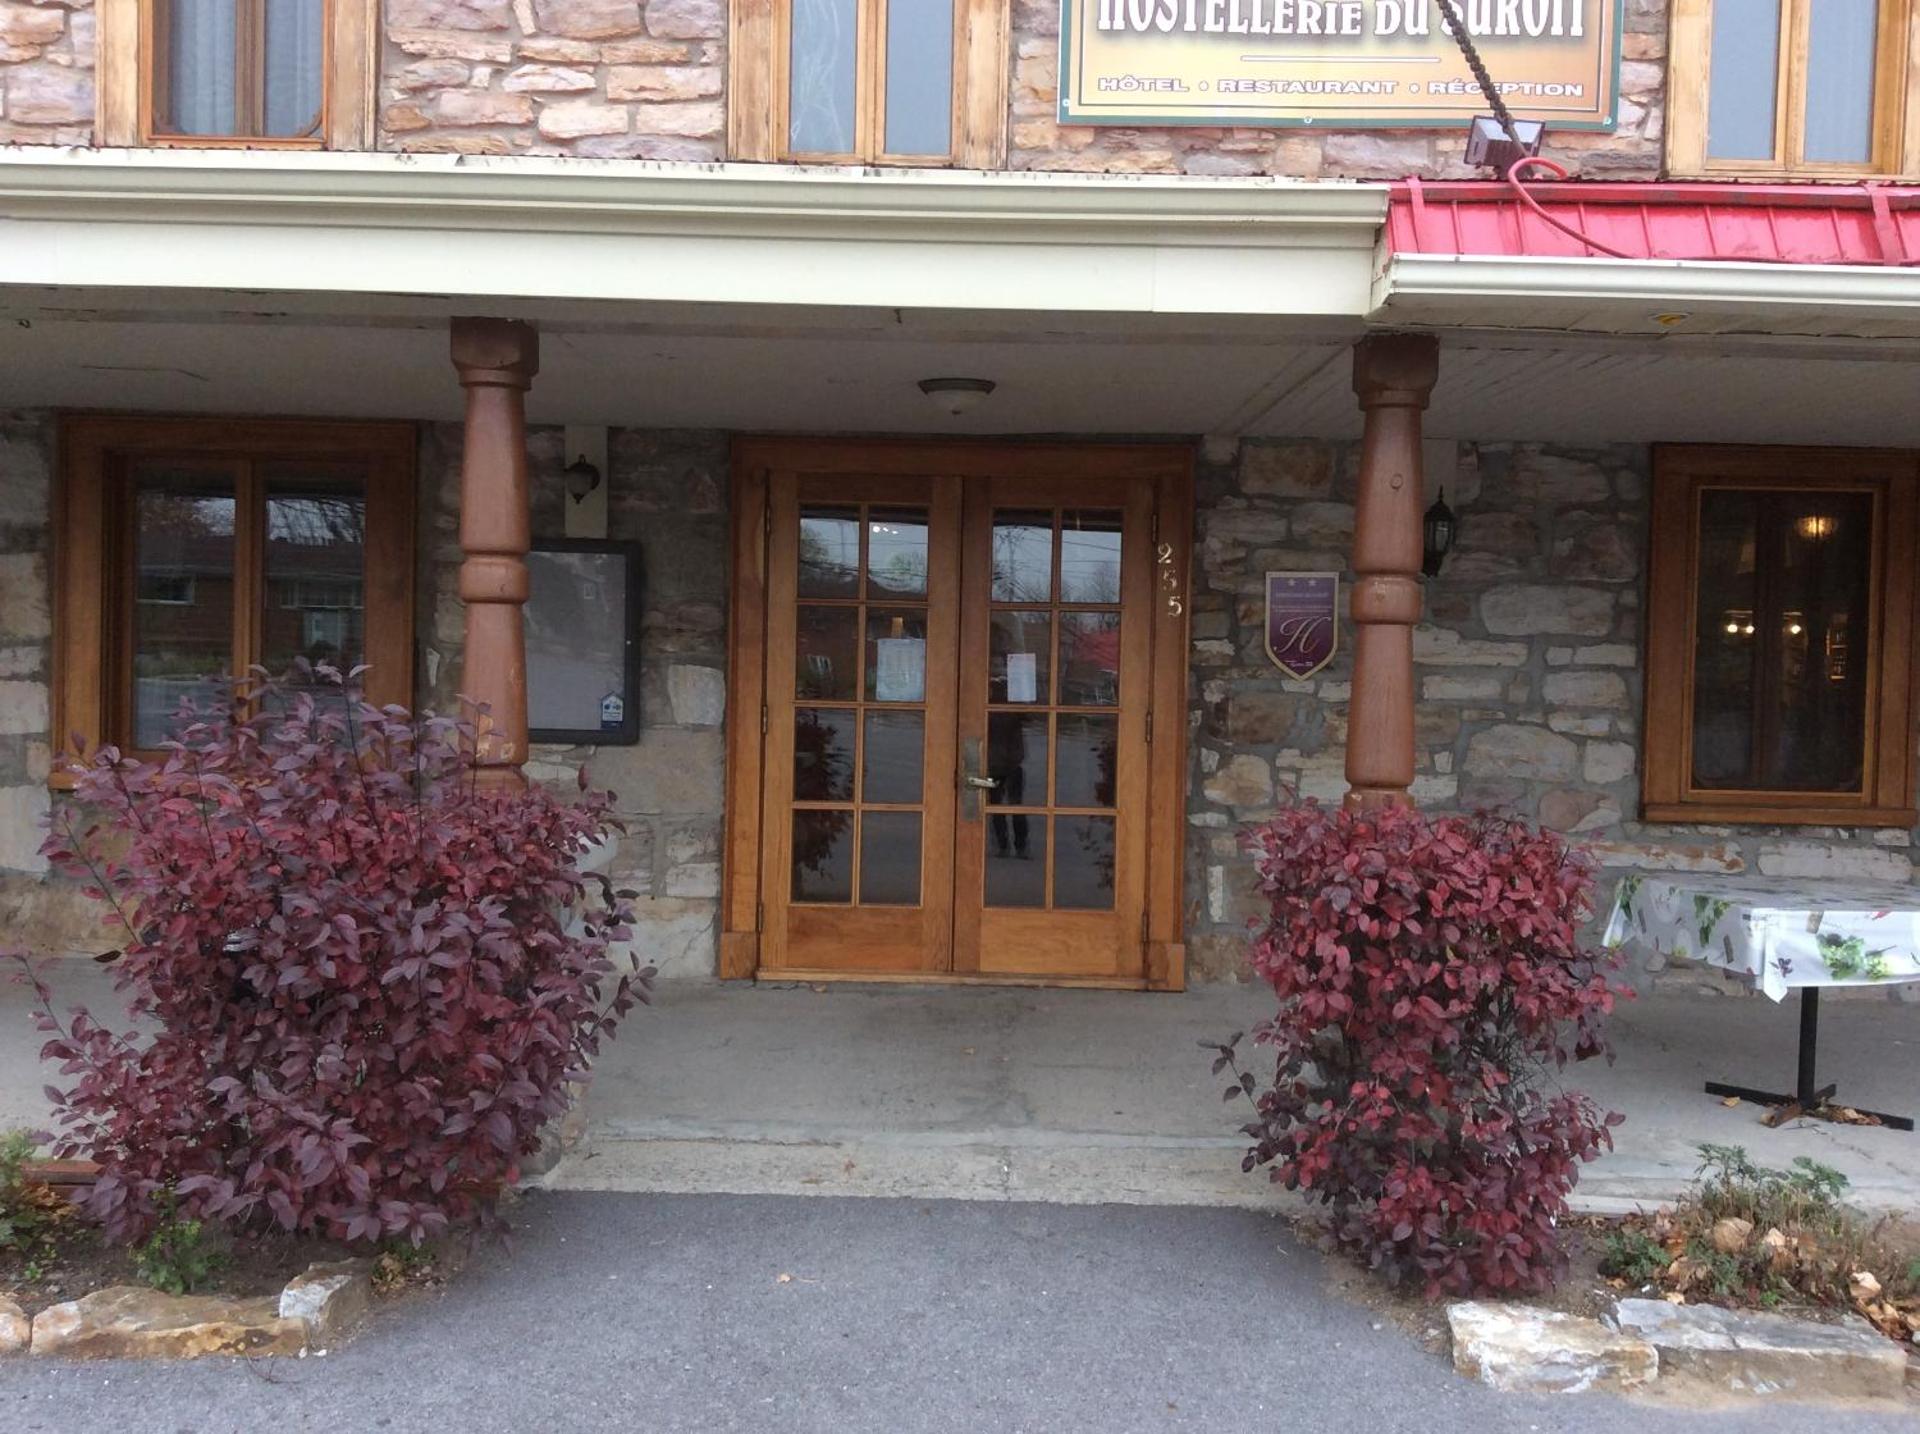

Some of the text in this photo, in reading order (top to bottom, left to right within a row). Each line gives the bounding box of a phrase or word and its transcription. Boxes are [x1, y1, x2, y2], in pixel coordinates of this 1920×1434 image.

[1374, 0, 1429, 36] DU
[1098, 75, 1189, 93] HÔTEL
[1217, 80, 1397, 95] RESTAURANT
